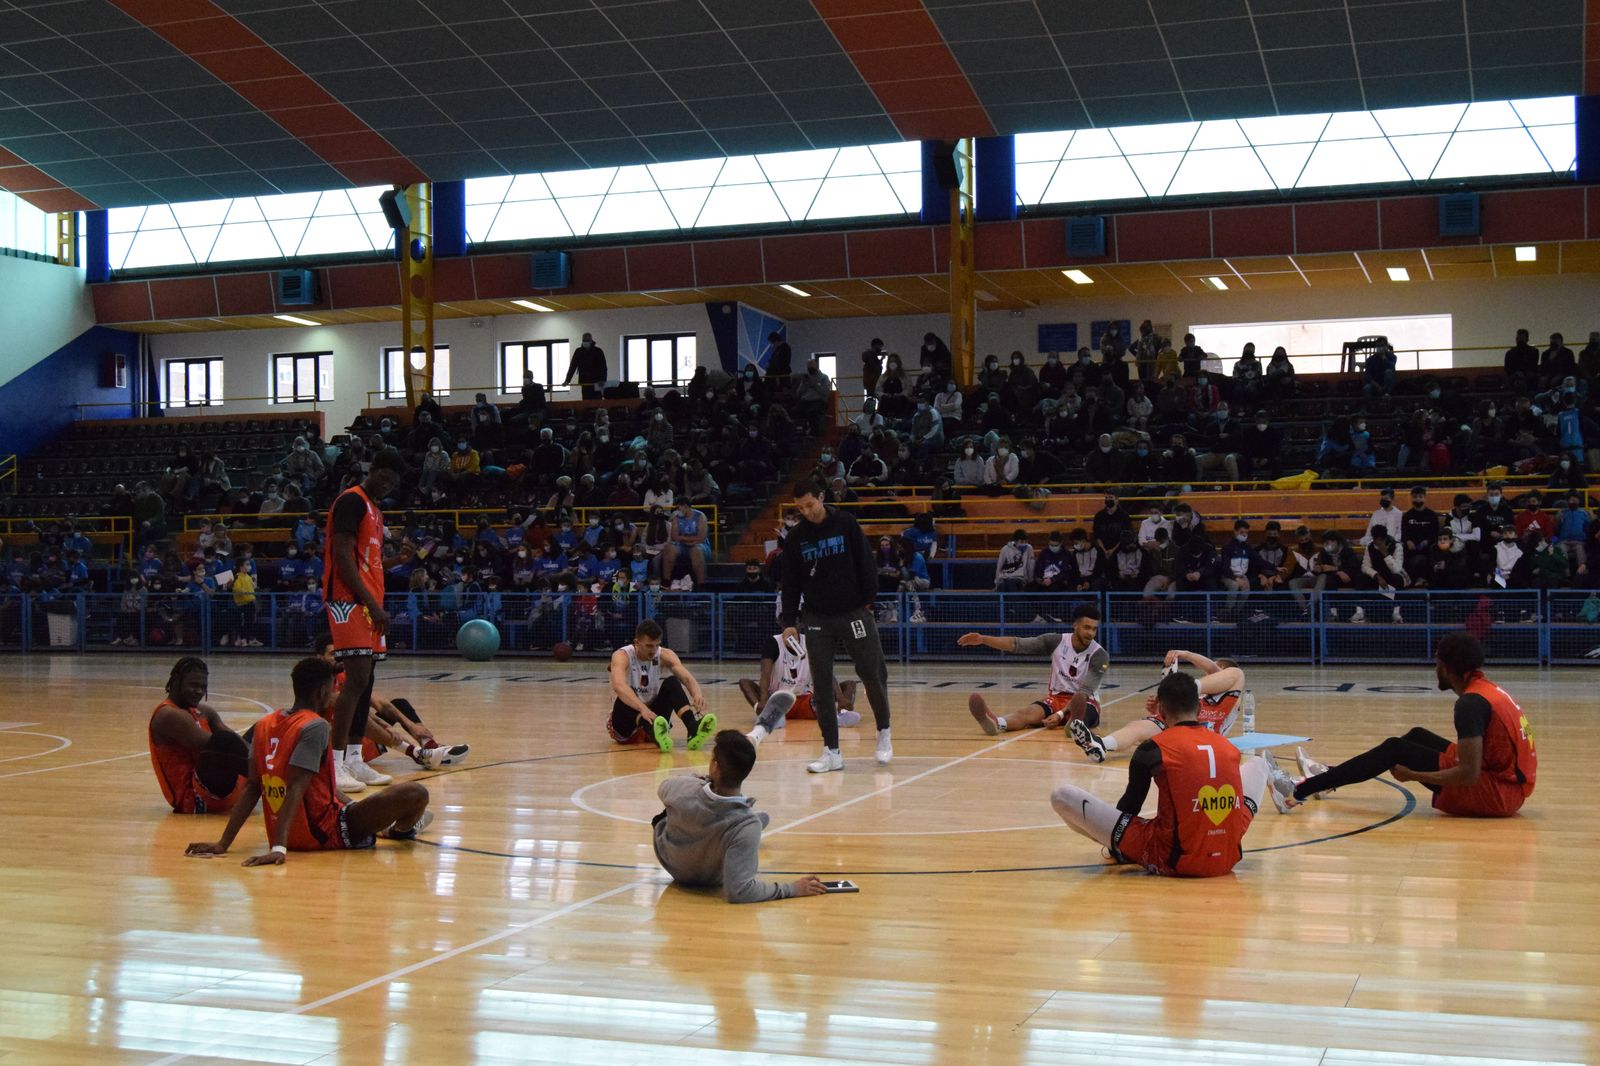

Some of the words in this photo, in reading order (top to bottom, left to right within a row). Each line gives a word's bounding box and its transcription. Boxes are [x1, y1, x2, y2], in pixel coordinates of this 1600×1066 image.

[1282, 682, 1433, 694] de
[264, 737, 280, 770] 2
[1196, 744, 1217, 779] 7
[1192, 795, 1242, 813] ZAMORA
